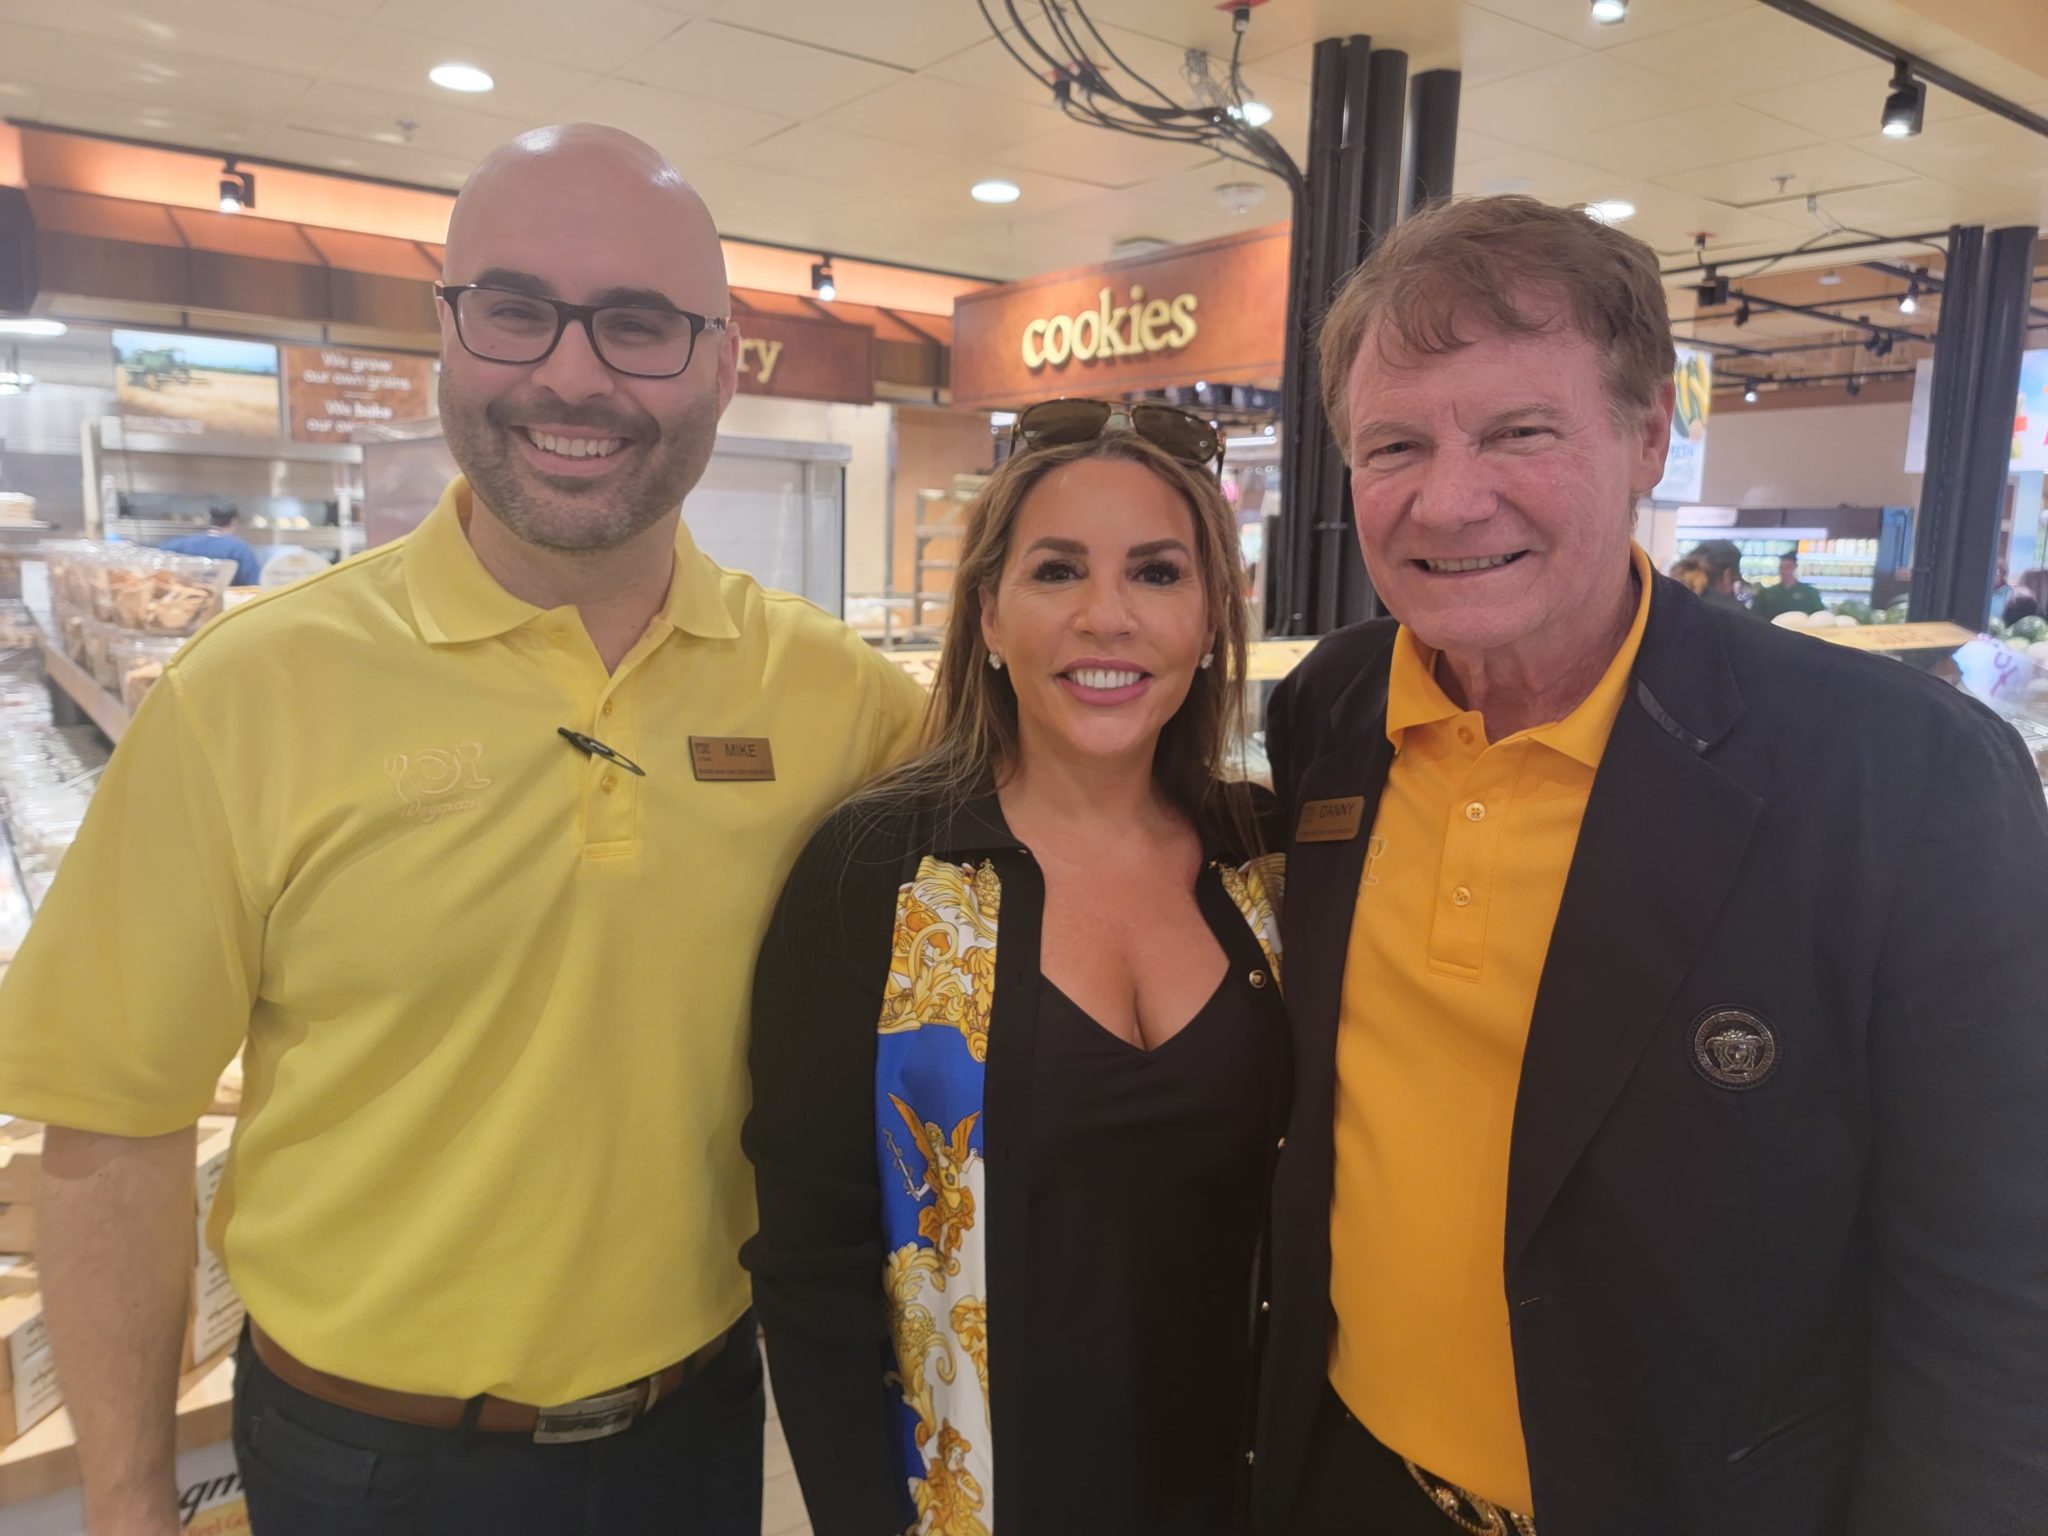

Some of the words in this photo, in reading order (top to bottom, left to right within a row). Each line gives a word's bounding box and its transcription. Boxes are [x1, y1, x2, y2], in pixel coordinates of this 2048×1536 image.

[1022, 284, 1198, 369] cookies
[321, 351, 349, 369] We
[351, 356, 393, 373] grow
[736, 338, 784, 384] ry
[302, 369, 330, 385] our
[331, 372, 365, 386] own
[366, 374, 412, 391] grains
[324, 400, 351, 417] We
[353, 401, 393, 420] bake
[306, 418, 333, 432] our
[334, 420, 360, 433] ow
[724, 743, 758, 758] MIKE
[1319, 802, 1357, 819] DANNY
[178, 1471, 241, 1531] gm
